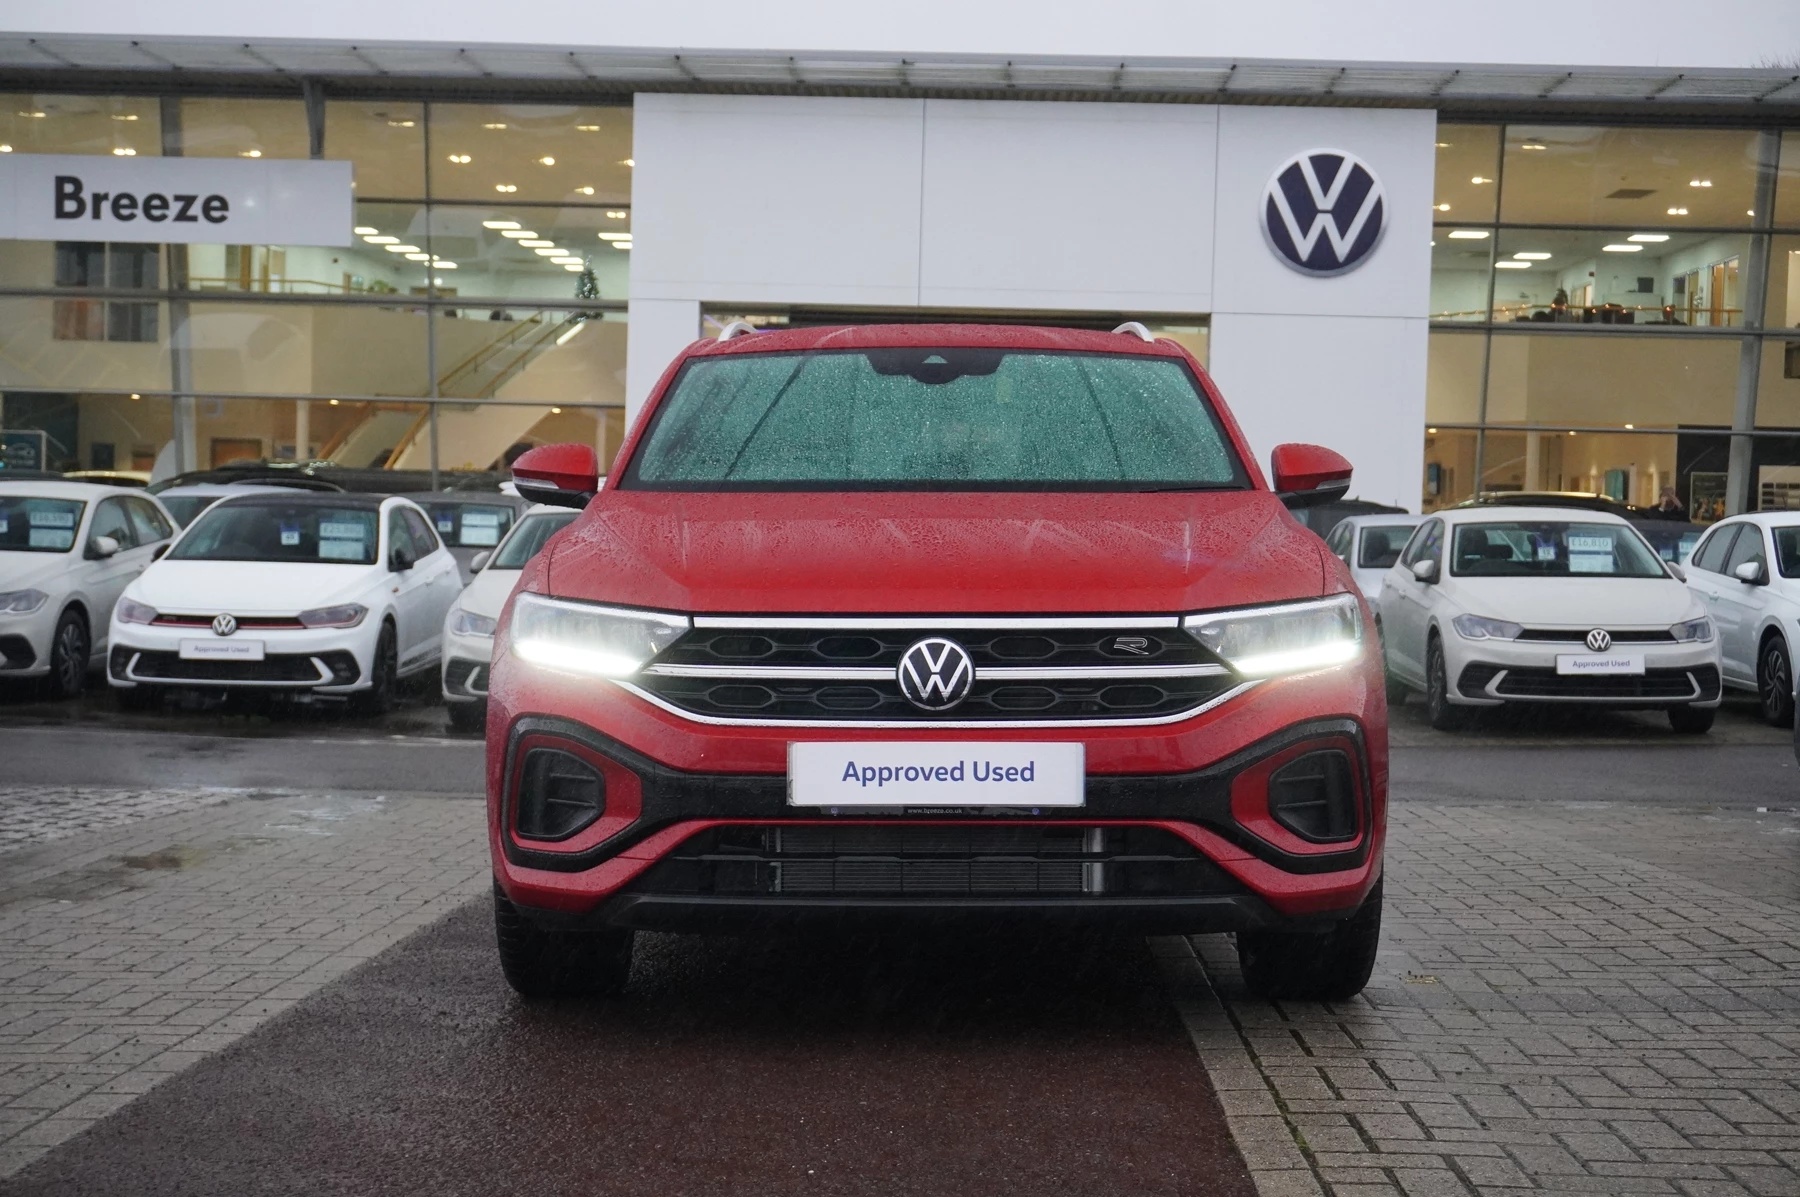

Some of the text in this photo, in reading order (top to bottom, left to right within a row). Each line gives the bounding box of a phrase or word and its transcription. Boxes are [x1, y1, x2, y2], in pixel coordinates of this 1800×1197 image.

[54, 175, 230, 224] Breeze
[193, 644, 229, 654] Approved
[1572, 660, 1609, 669] Approved
[841, 760, 1035, 787] Approved Used
